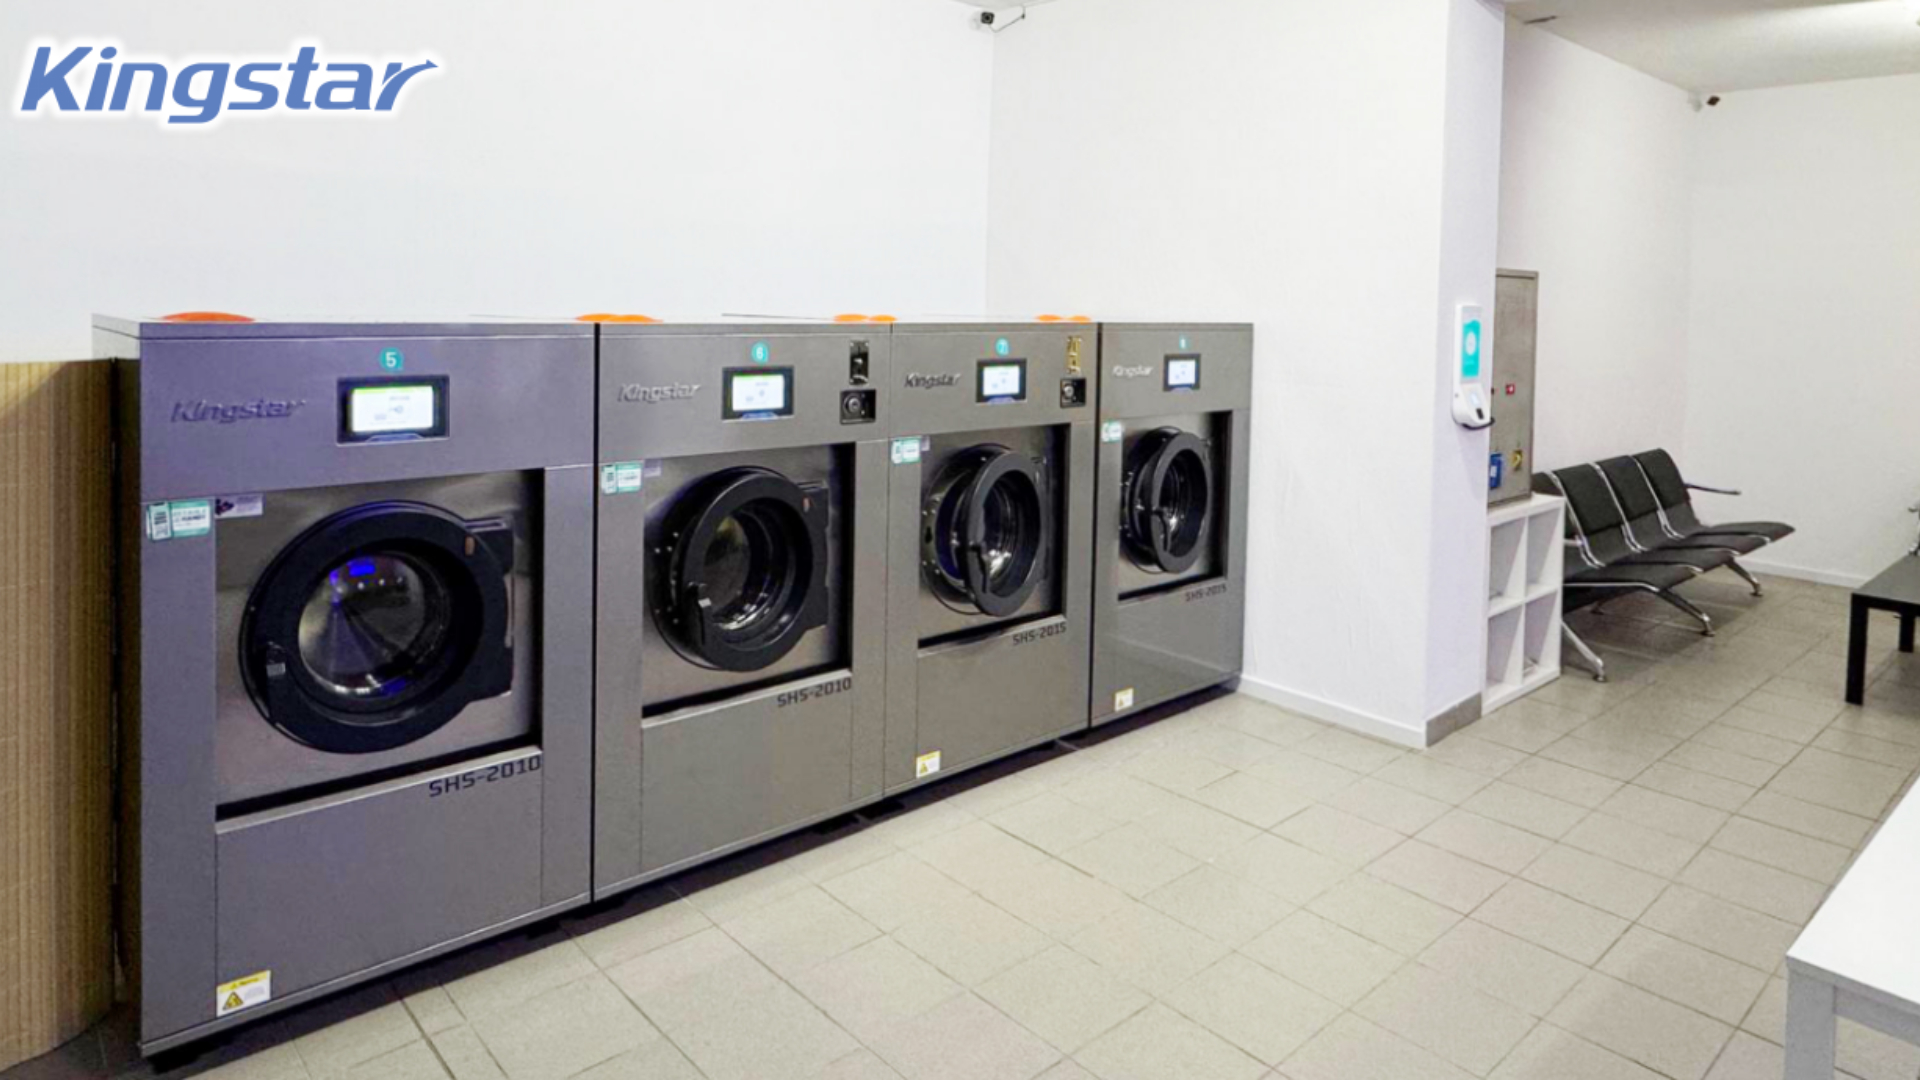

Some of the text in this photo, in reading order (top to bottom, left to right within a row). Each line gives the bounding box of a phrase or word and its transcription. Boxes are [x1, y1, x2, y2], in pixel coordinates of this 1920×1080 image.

[385, 352, 397, 368] 5
[904, 372, 961, 389] Kingstar
[618, 383, 700, 404] Kingstar
[171, 400, 306, 424] Kingstar
[1013, 623, 1067, 645] SHS-2015
[777, 677, 852, 707] SHS-2010
[429, 755, 541, 797] SHS-2010
